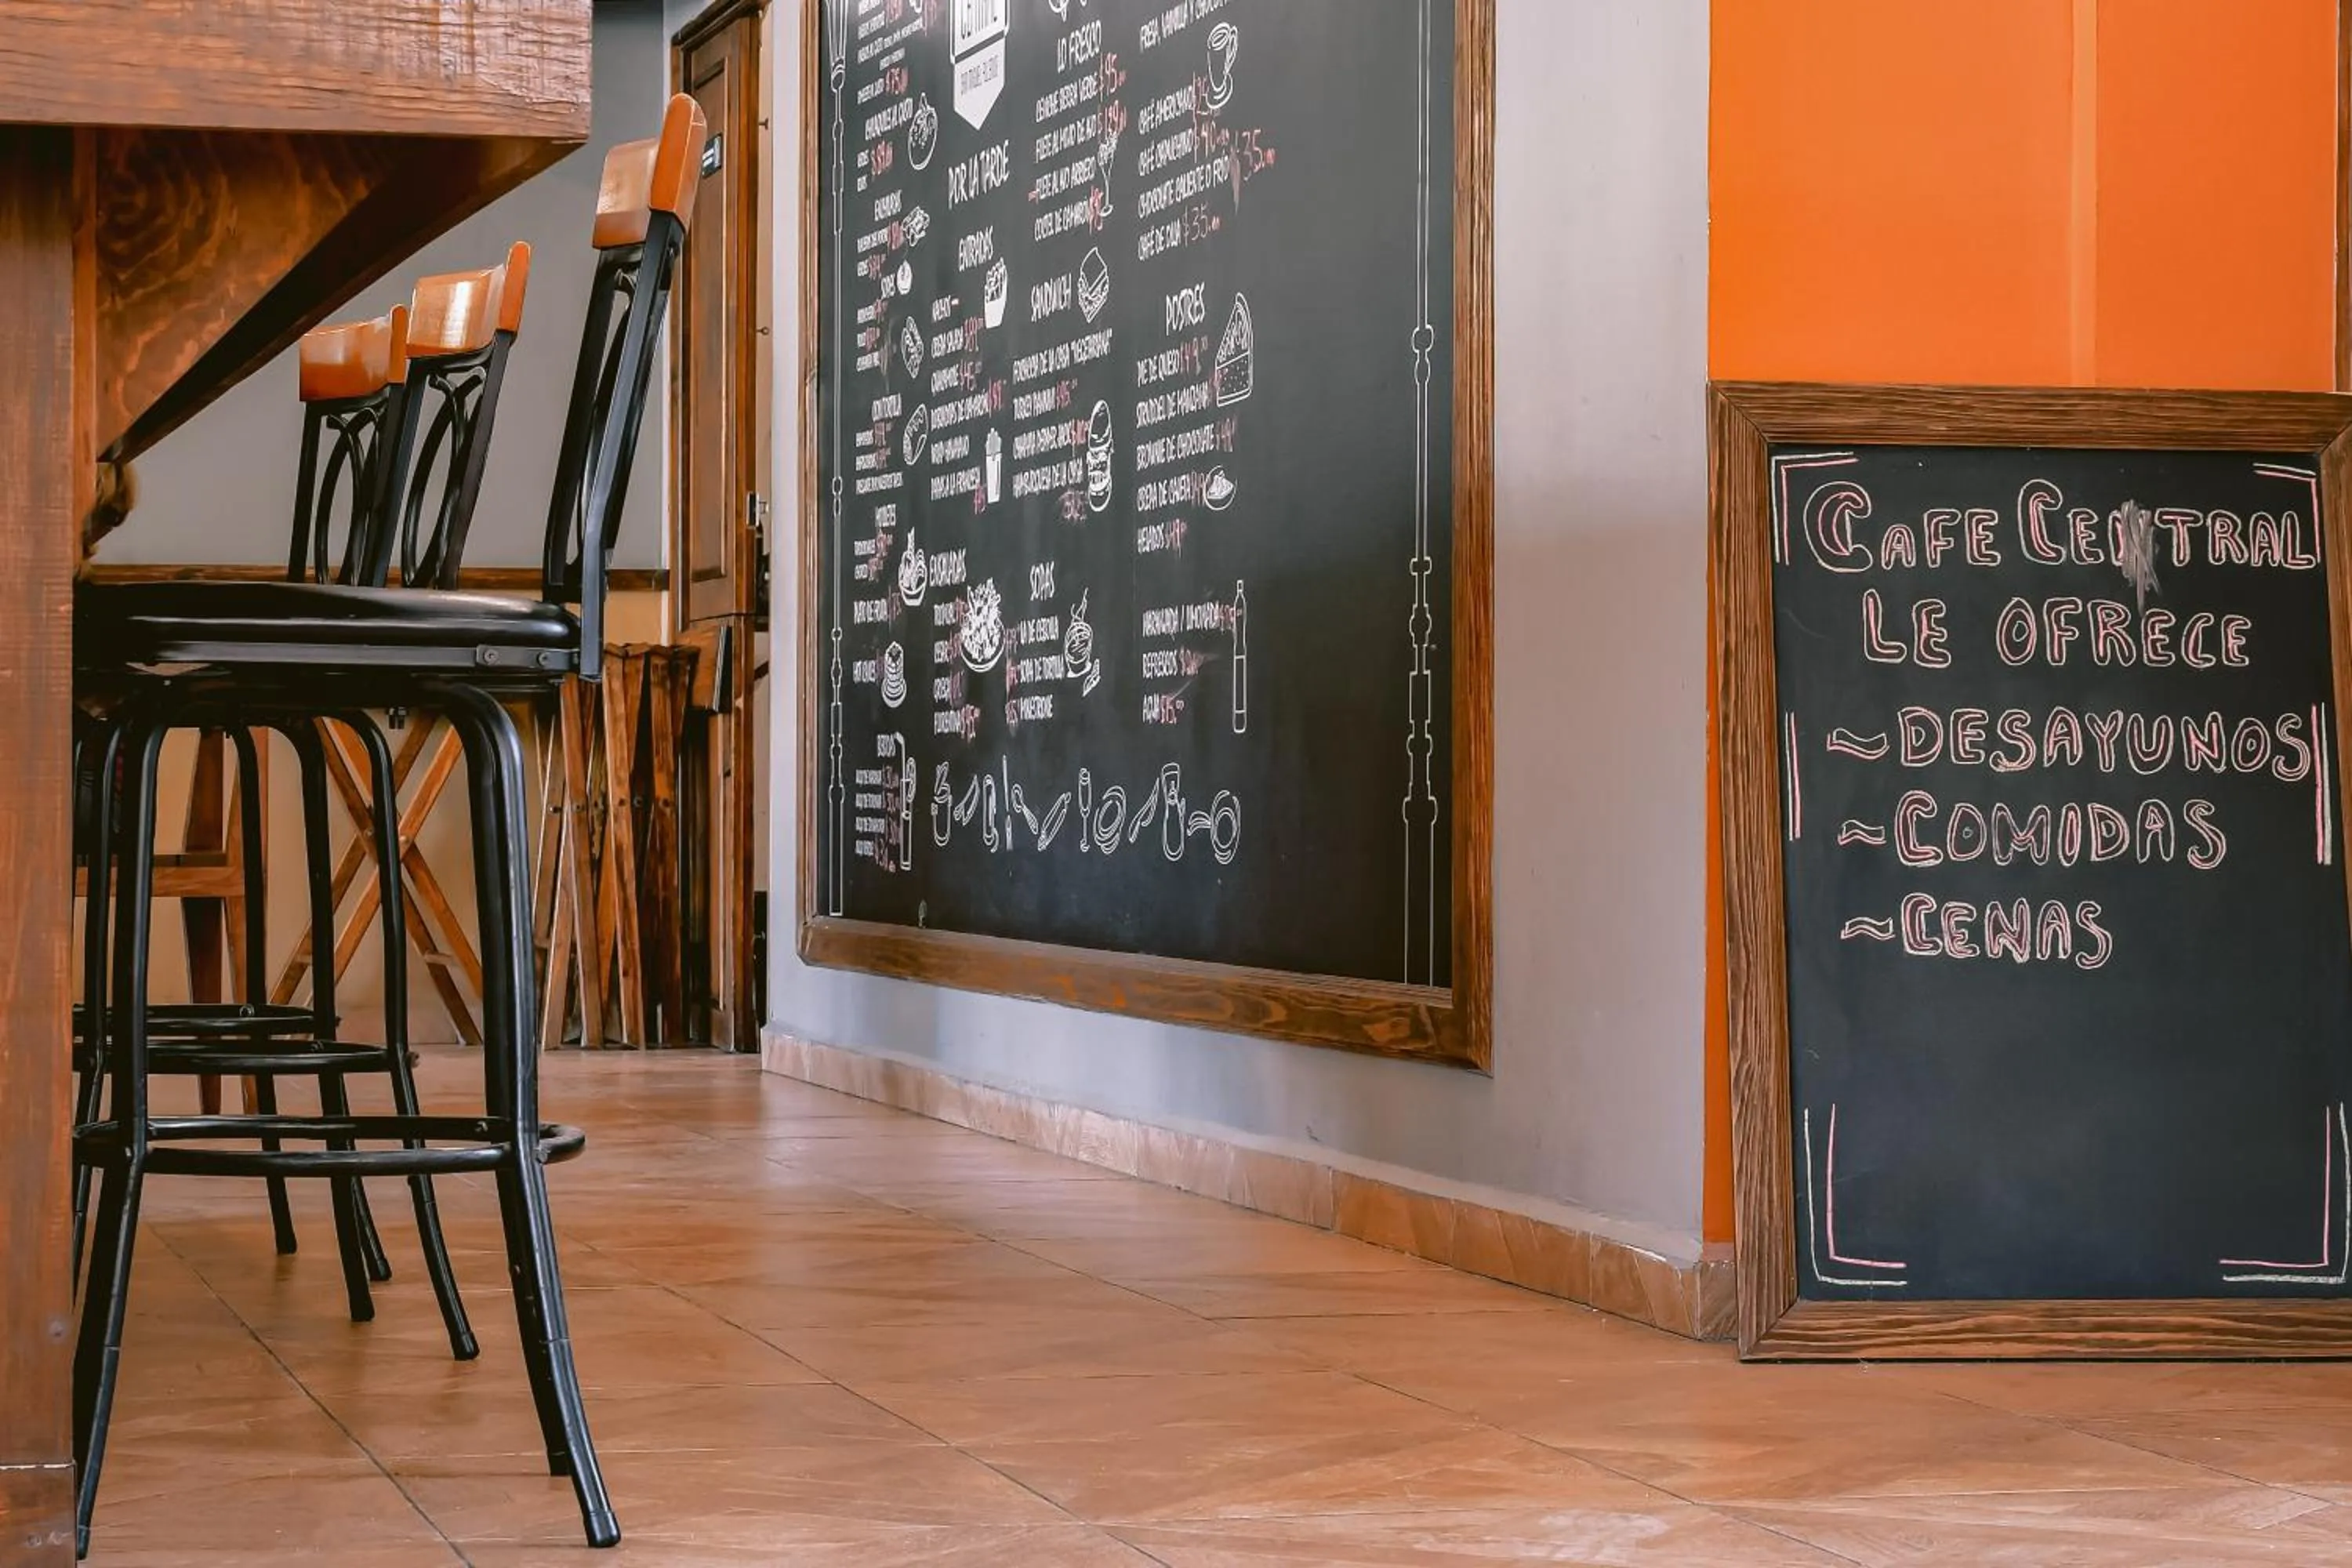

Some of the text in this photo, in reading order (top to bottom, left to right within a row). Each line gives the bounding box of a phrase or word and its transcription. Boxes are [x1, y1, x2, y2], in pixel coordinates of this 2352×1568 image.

[1057, 20, 1102, 73] LO FRESCO
[948, 139, 1010, 209] POR LA TARDE
[1031, 273, 1071, 322] SANDWICH
[1165, 281, 1204, 336] POSTRES
[1803, 481, 2001, 572] CAFE
[1029, 561, 1054, 601] SOPAS
[1863, 589, 2252, 667] LE OFRECE
[1897, 706, 2311, 781] DESAYUNOS
[1894, 789, 2227, 869] COMIDAS
[1900, 891, 2114, 970] CENAS
